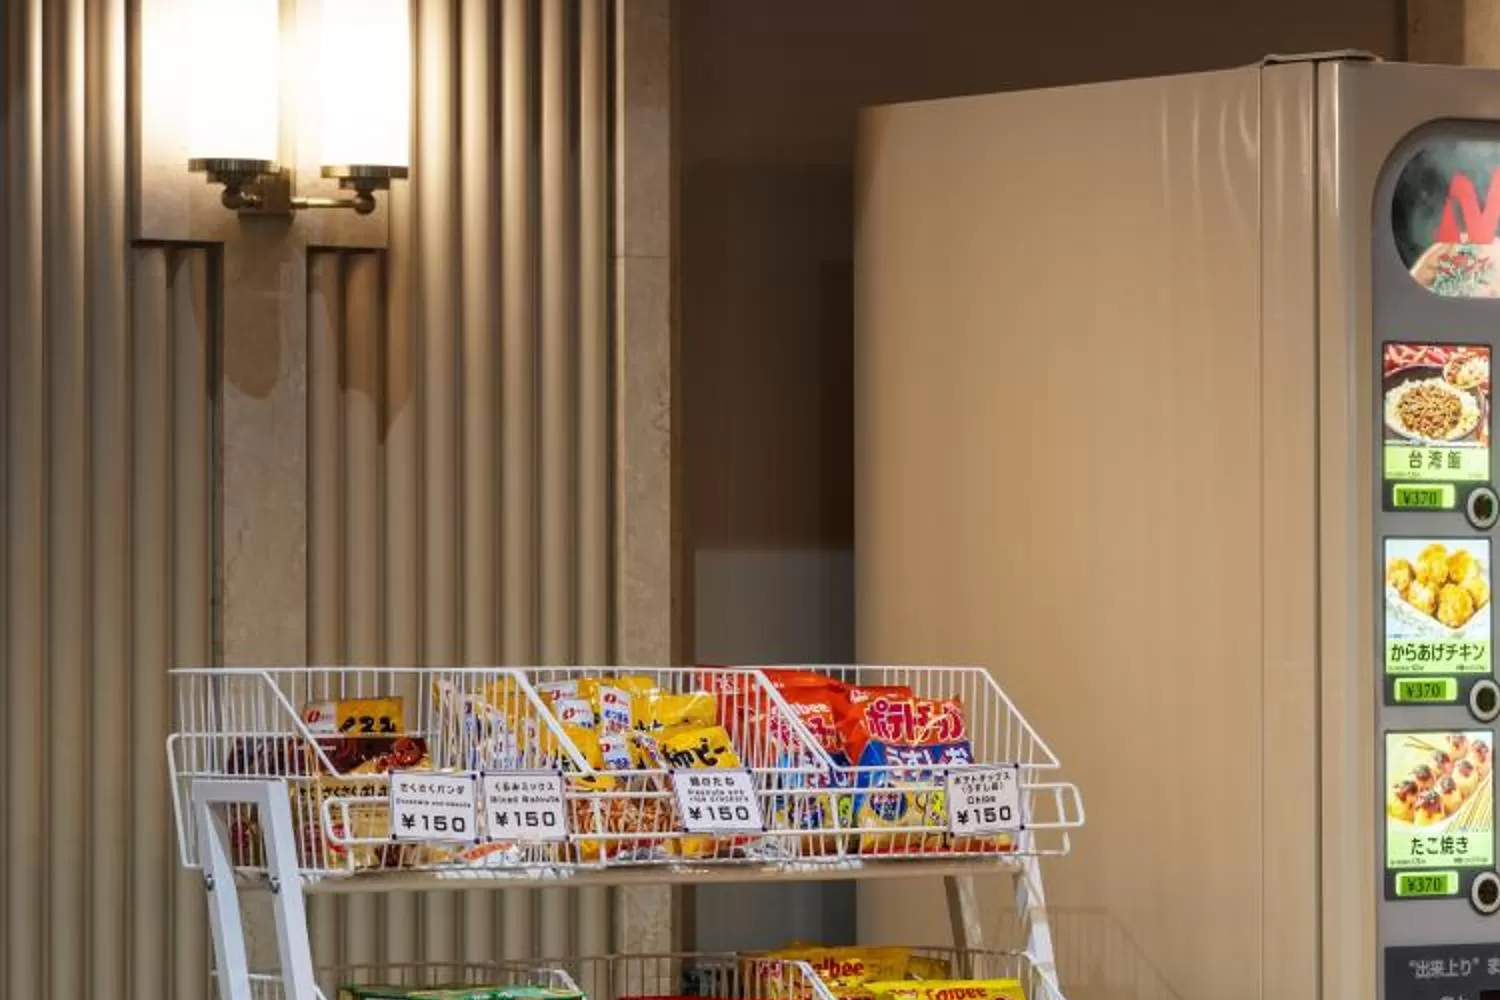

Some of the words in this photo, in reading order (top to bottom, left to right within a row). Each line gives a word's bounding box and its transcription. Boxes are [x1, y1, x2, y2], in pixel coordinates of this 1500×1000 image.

[1391, 642, 1485, 662] からあげチキン
[401, 812, 466, 833] ¥150
[495, 810, 556, 828] ¥150
[688, 805, 749, 821] ¥150
[956, 805, 1012, 825] ¥150
[1410, 833, 1470, 856] たこ焼き
[1406, 875, 1442, 893] ¥370
